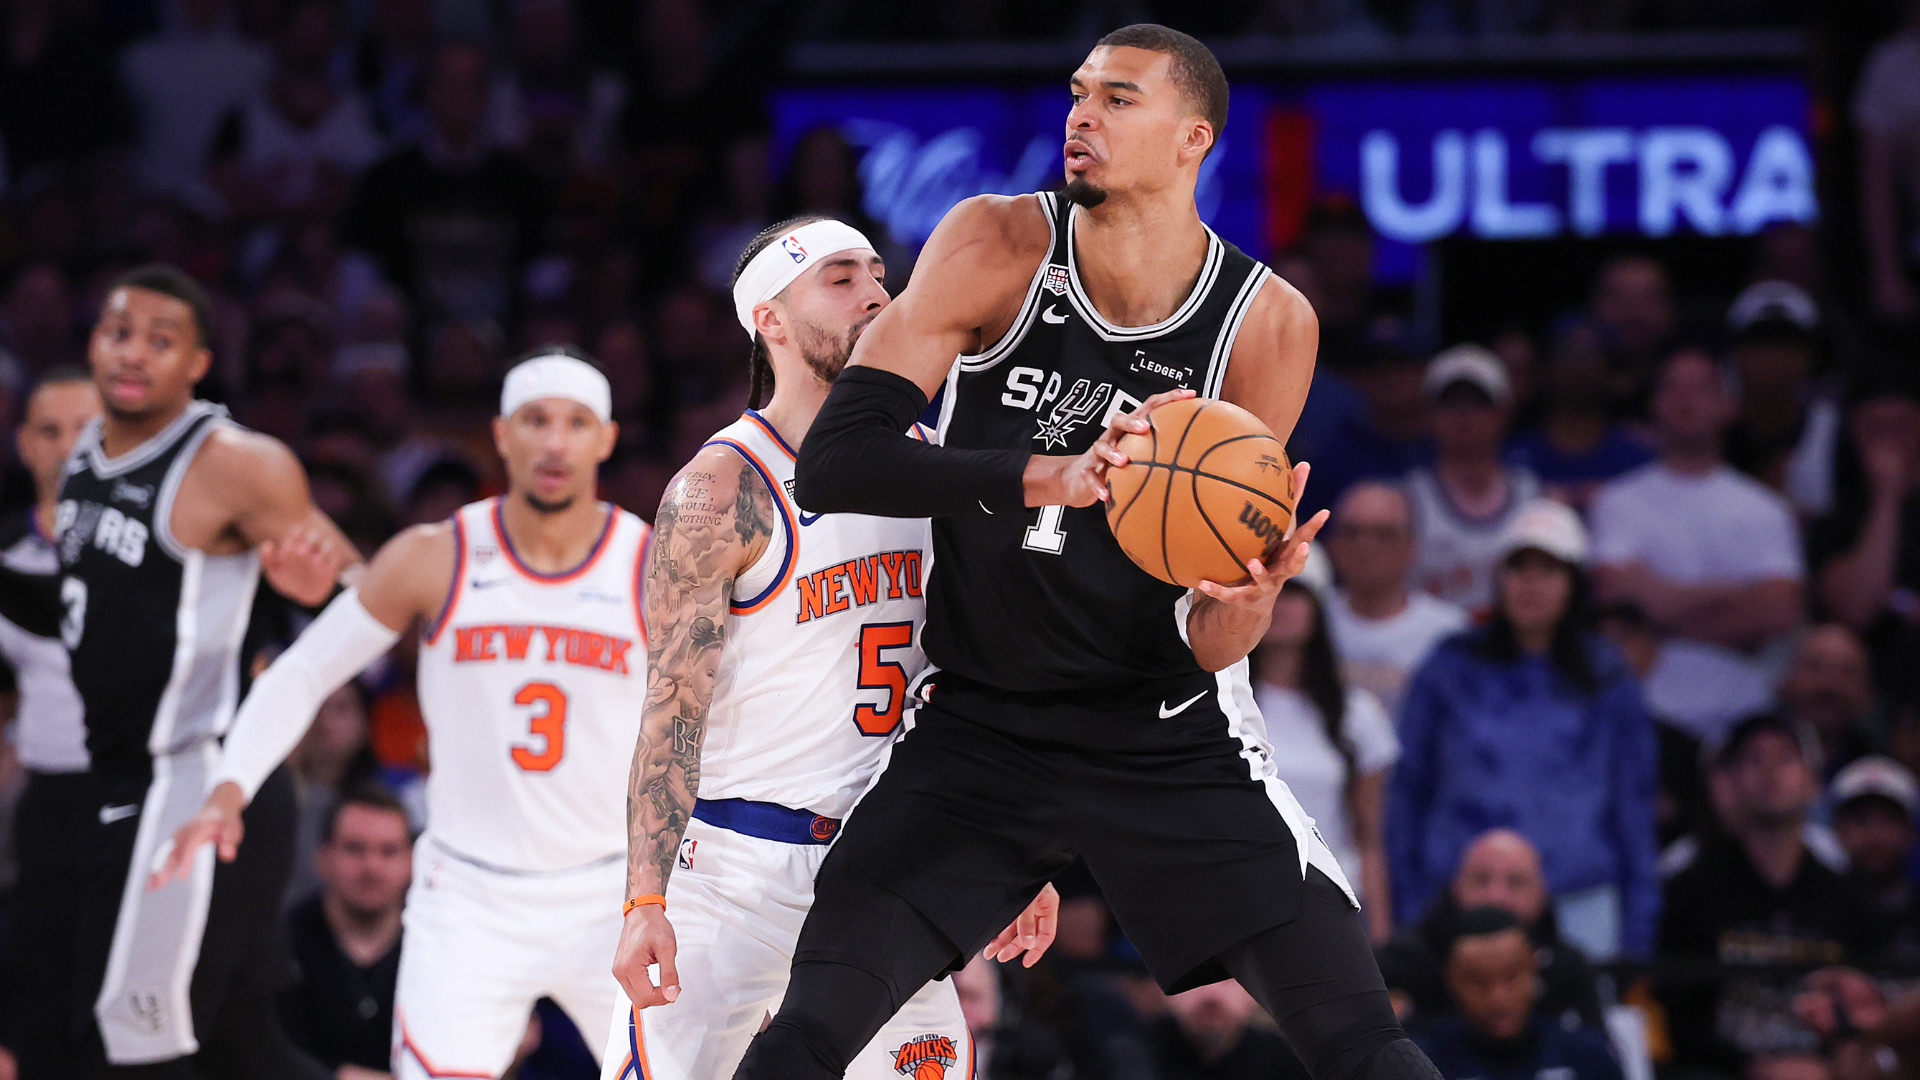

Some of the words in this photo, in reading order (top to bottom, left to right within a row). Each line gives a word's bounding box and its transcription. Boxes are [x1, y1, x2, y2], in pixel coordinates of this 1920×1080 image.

[1360, 125, 1818, 242] ULTRA
[1139, 357, 1184, 382] LEDGER
[1001, 366, 1144, 450] SPUR
[796, 556, 879, 625] NEW
[454, 624, 535, 663] NEW
[540, 625, 633, 676] YORK
[852, 620, 914, 737] 5
[510, 681, 567, 772] 3
[671, 715, 702, 761] B4
[894, 1036, 958, 1070] KNICKS
